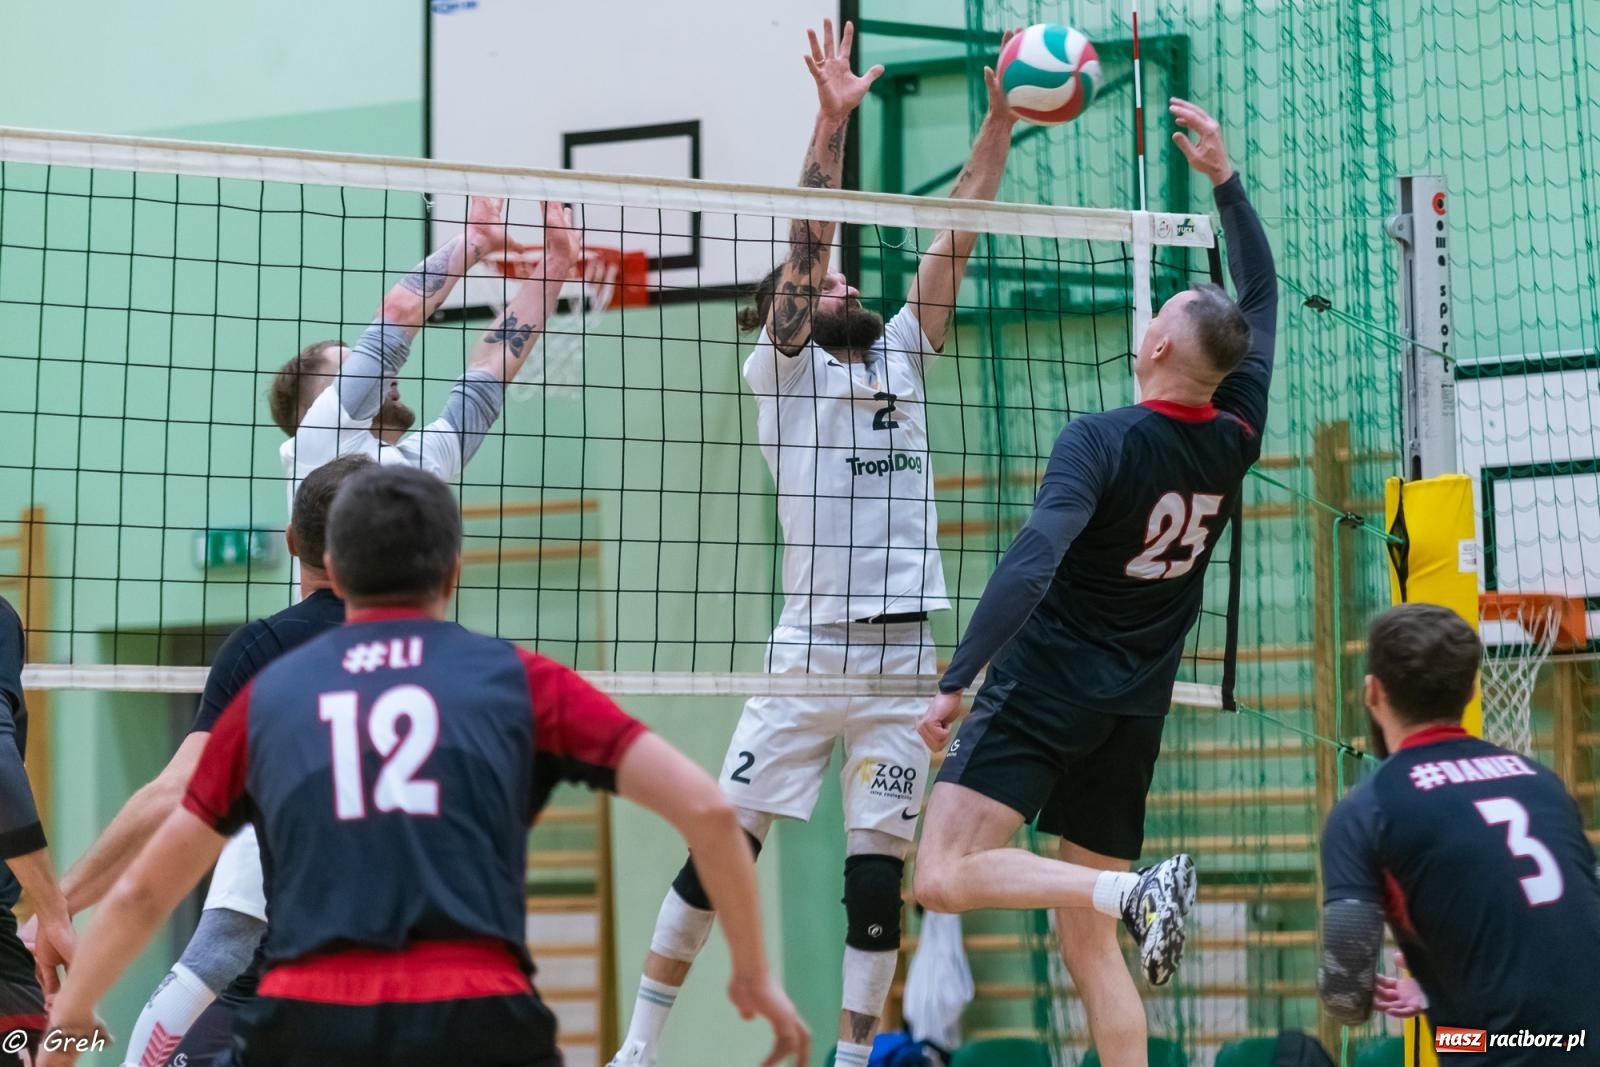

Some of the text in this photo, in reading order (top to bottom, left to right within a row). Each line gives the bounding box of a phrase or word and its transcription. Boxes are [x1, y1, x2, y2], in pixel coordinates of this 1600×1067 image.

[1439, 285, 1449, 373] sport
[872, 391, 900, 431] 2
[845, 453, 922, 477] TropiDog
[1123, 491, 1225, 580] 25
[342, 636, 424, 674] #LI
[318, 683, 441, 821] 12
[730, 750, 755, 785] 2
[871, 777, 913, 795] MAR
[876, 763, 917, 781] ZOO
[1409, 754, 1538, 791] #DANIEL
[1472, 796, 1564, 907] 3
